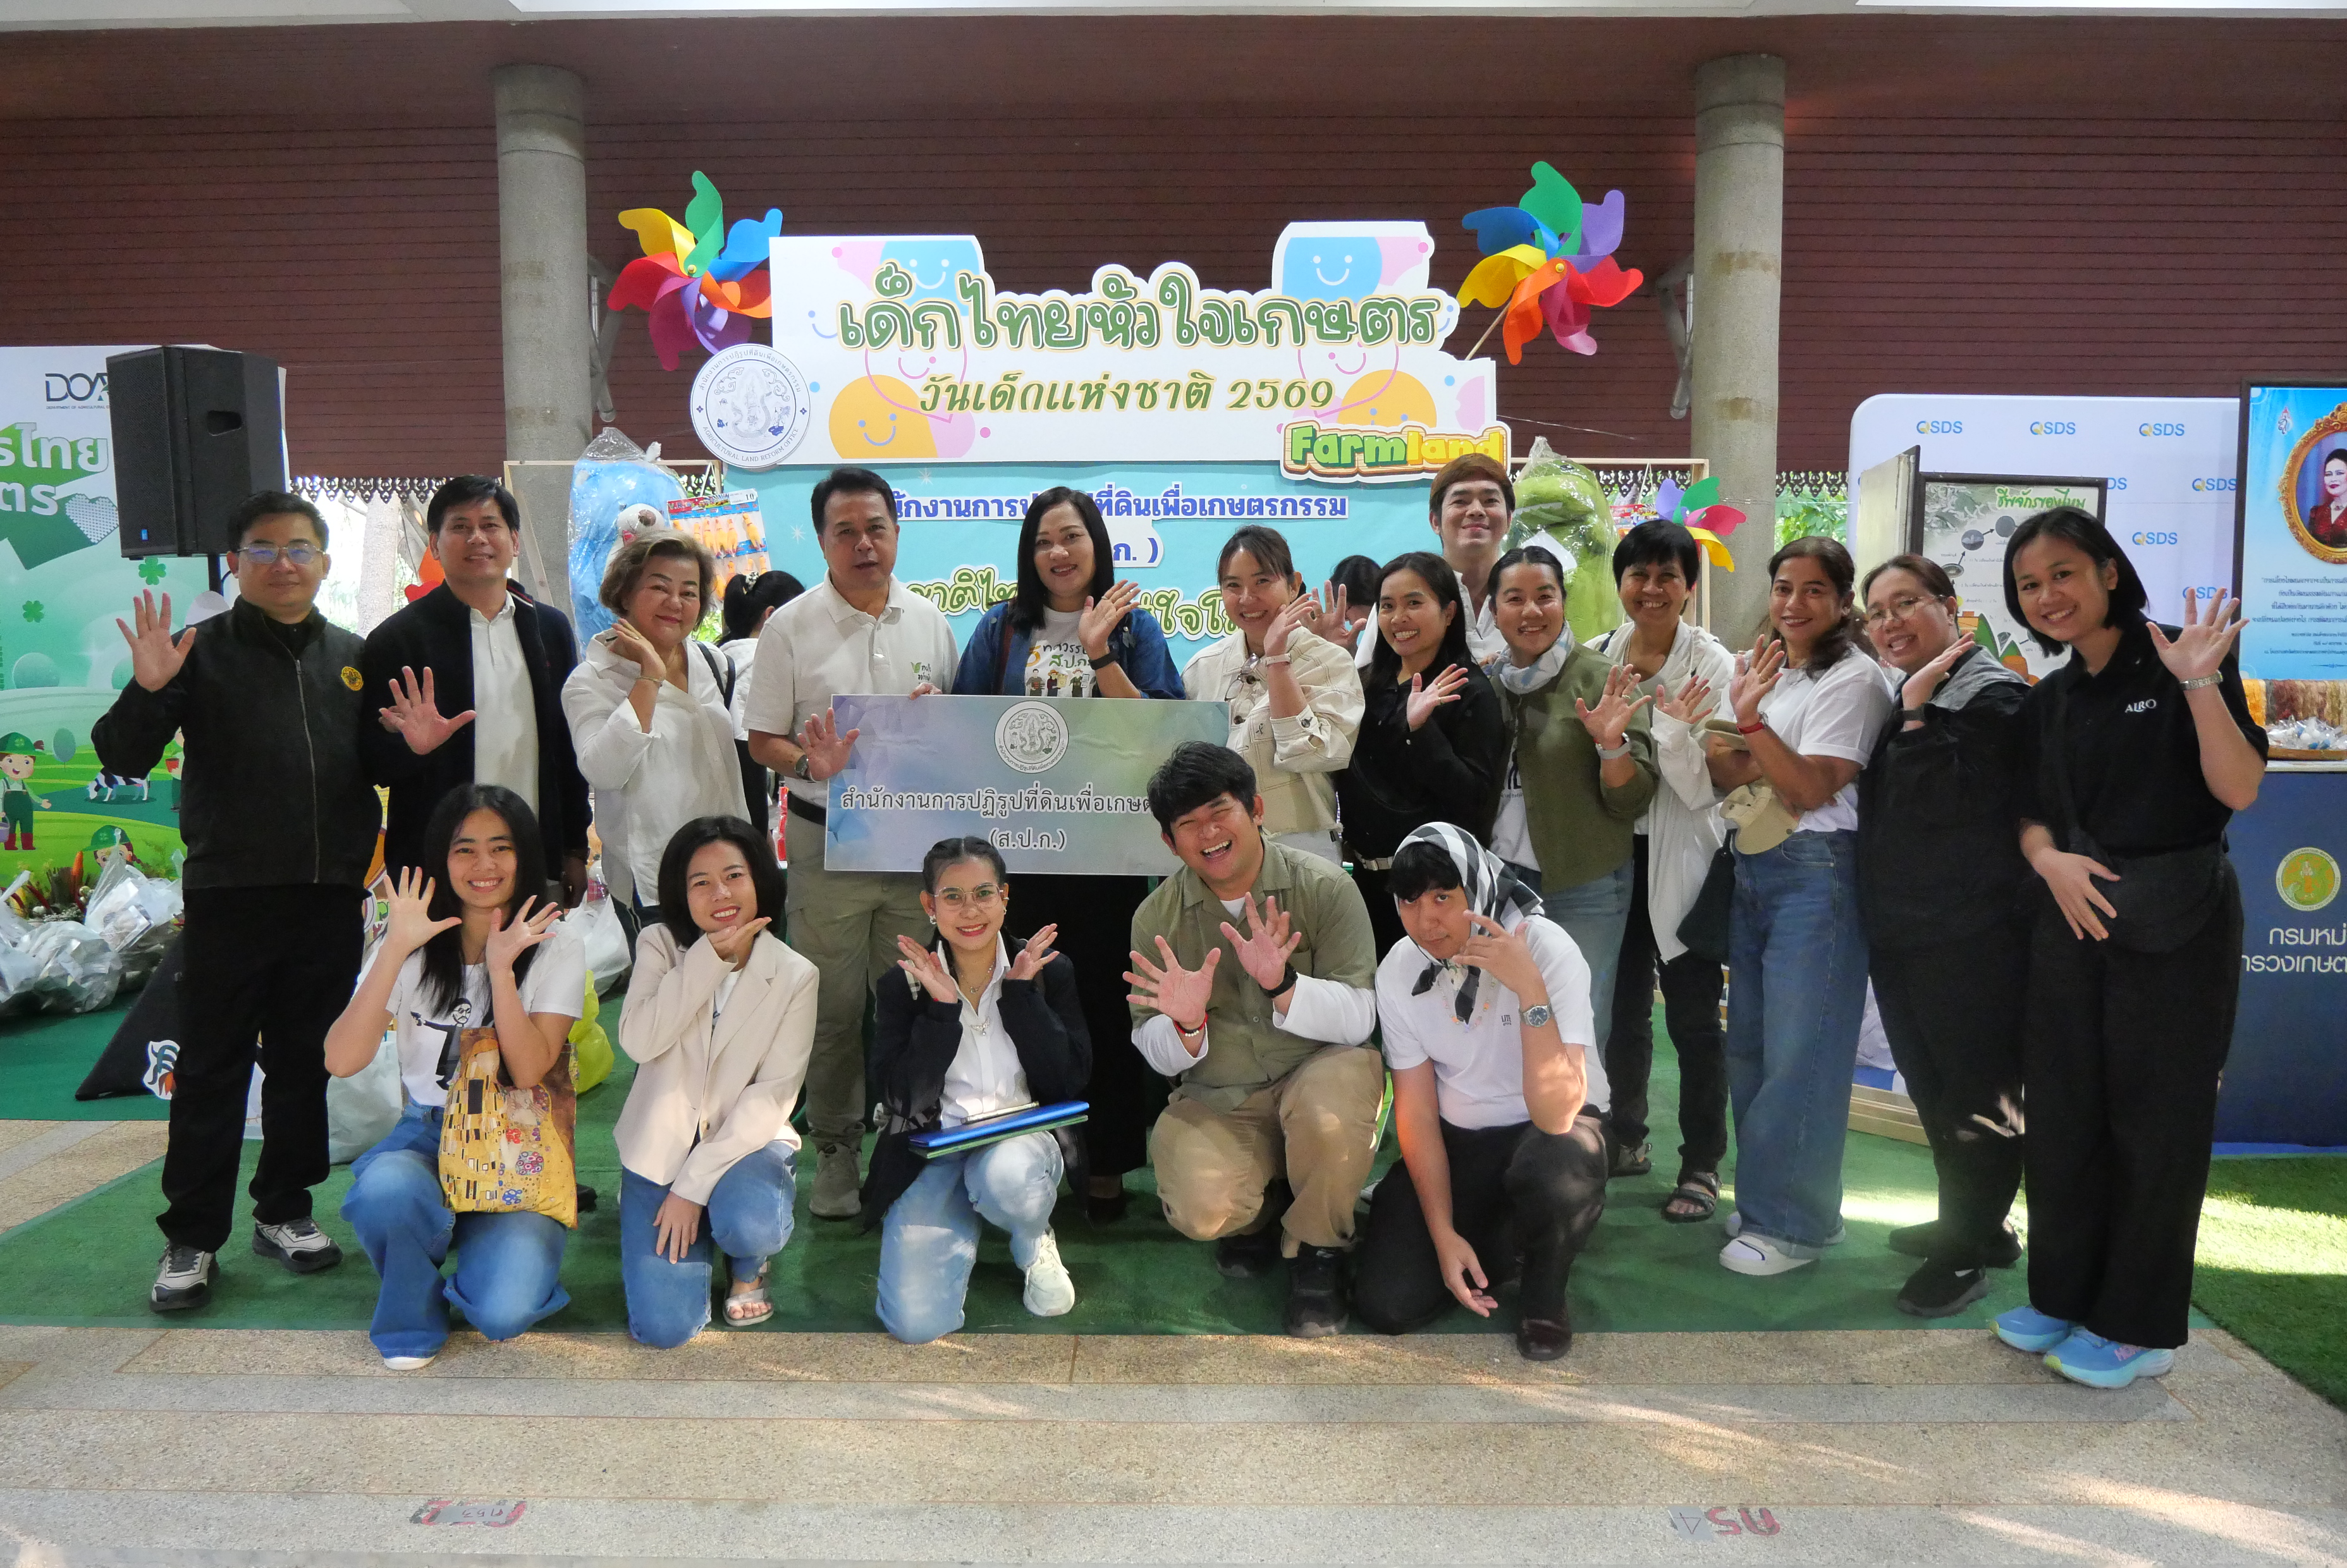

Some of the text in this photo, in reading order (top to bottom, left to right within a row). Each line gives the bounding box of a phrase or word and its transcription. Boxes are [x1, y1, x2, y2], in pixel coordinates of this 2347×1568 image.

[920, 372, 1333, 411] วันเด็กแห่งชาติ 2569
[1916, 420, 1963, 434] QSDS
[2030, 421, 2076, 435] QSDS
[2138, 422, 2185, 437] QSDS
[703, 426, 739, 460] AGRICULTURAL
[761, 447, 785, 461] REFORM
[784, 427, 799, 448] OFFICE
[1290, 425, 1504, 468] Farmland
[2131, 532, 2178, 546] QSDS
[2124, 699, 2157, 713] ALRO
[990, 829, 1066, 850] (ส.ป.ก.)
